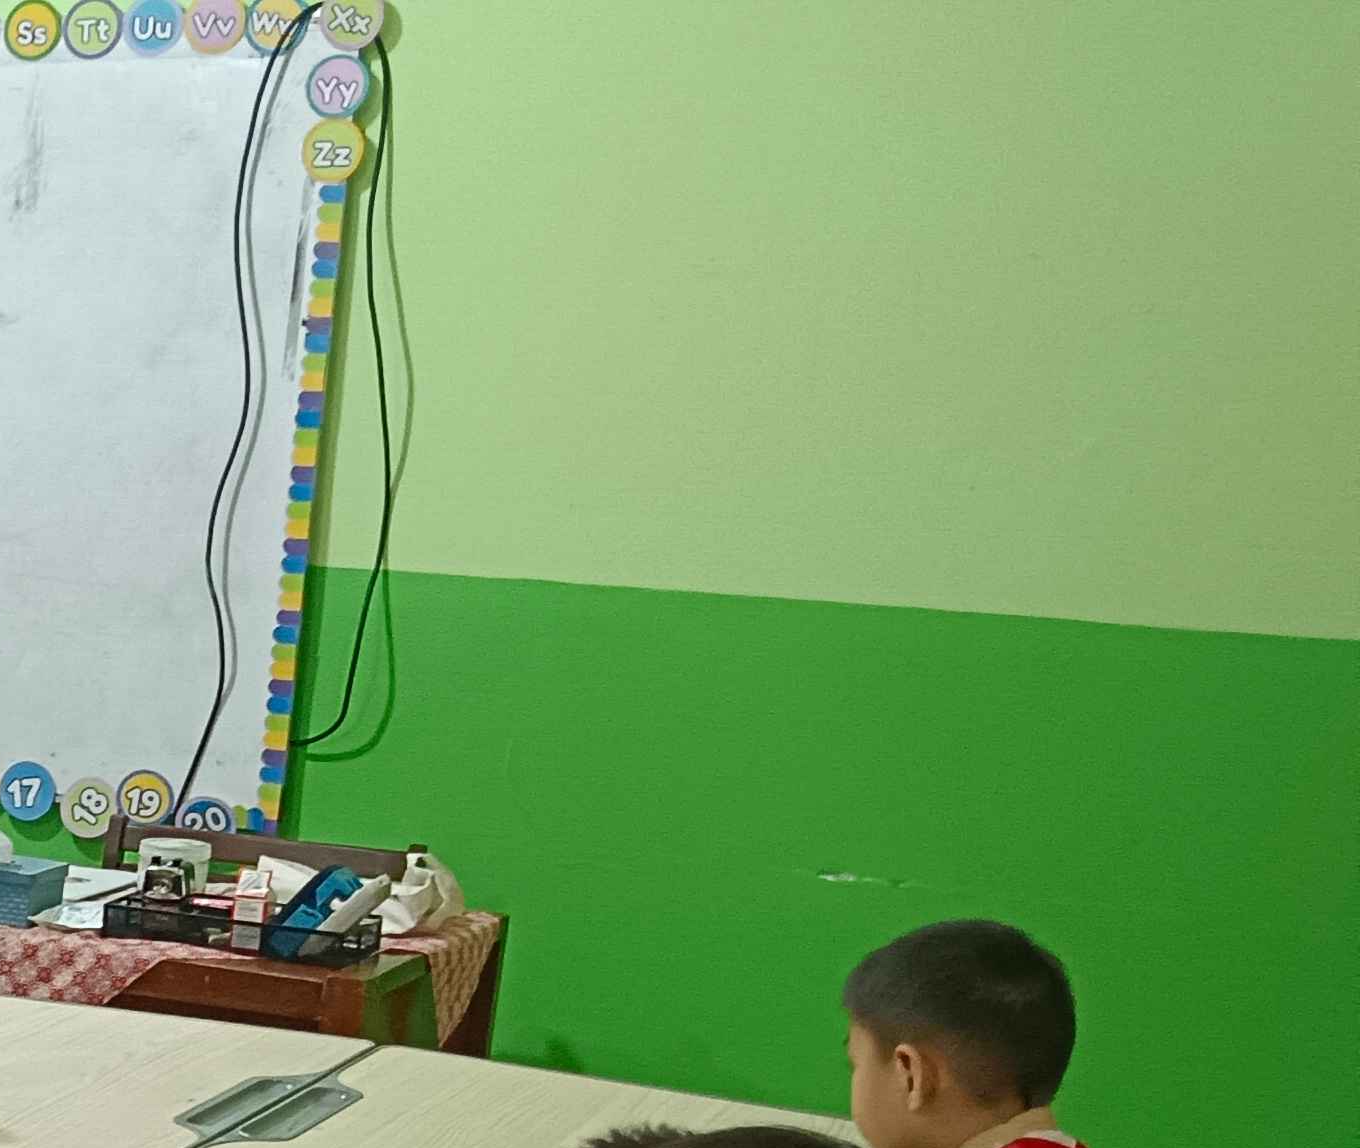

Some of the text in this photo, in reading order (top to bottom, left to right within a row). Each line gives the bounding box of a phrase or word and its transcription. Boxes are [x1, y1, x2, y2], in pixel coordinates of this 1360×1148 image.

[17, 21, 47, 45] Ss
[76, 19, 111, 44] Tt
[133, 16, 172, 41] Uu
[192, 13, 235, 38] Vv
[329, 6, 372, 36] Xx
[316, 77, 358, 108] Yy
[312, 142, 353, 168] Zz
[6, 777, 42, 808] 17
[72, 786, 110, 826] 18
[125, 786, 161, 816] 19
[184, 806, 227, 832] 20
